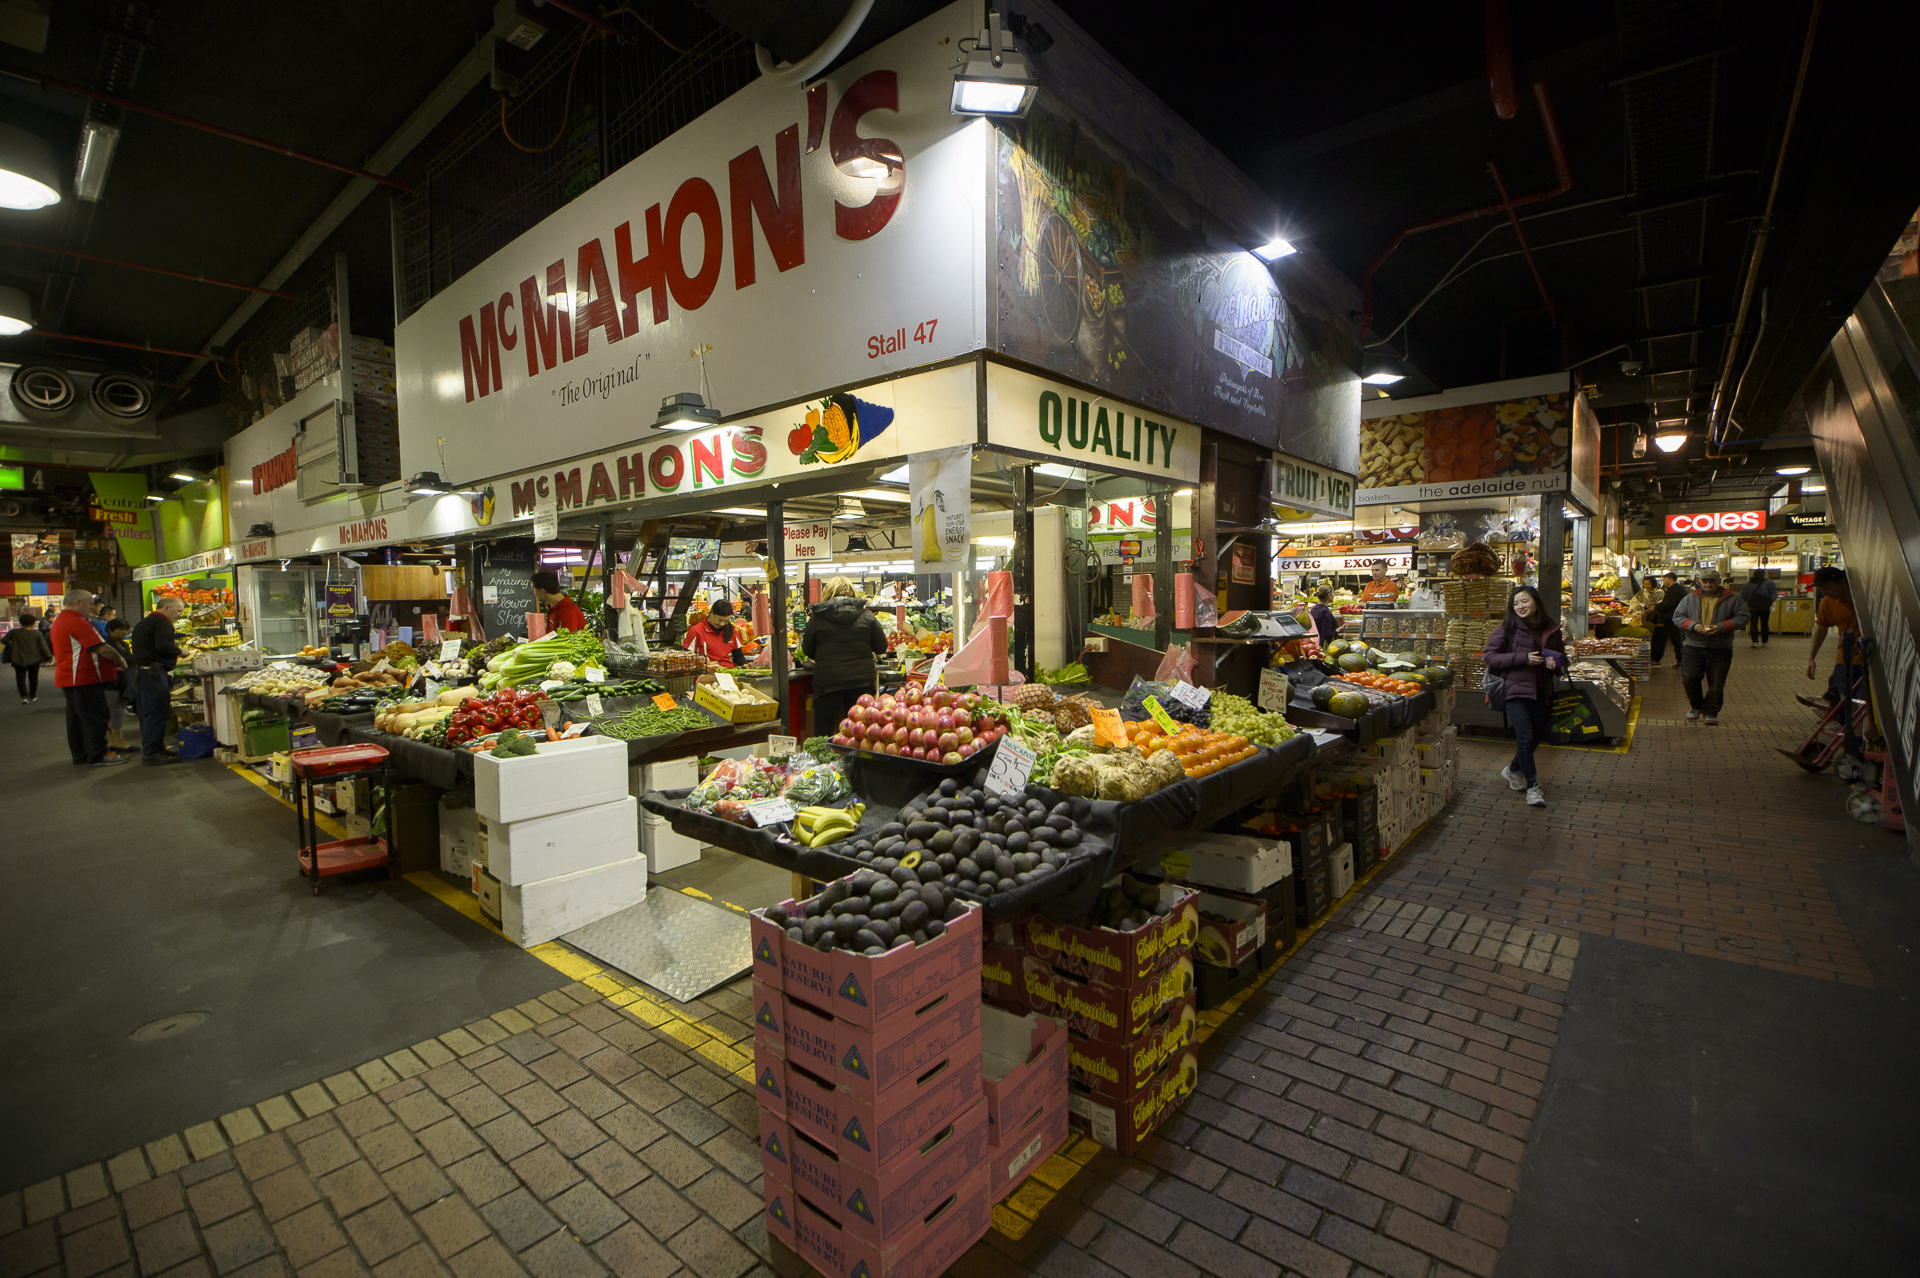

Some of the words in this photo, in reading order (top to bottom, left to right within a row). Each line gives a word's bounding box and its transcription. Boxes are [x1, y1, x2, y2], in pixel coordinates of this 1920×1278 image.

[458, 70, 906, 403] McMAHON'S
[866, 322, 908, 360] Stall
[913, 319, 939, 347] 47
[1038, 389, 1178, 469] QUALITY
[32, 469, 44, 490] 4
[510, 425, 768, 519] McMAHON'S
[1276, 459, 1320, 503] FRUIT
[1326, 475, 1350, 510] VEG
[1418, 486, 1443, 498] the
[1448, 480, 1526, 496] adelaide
[1532, 475, 1561, 490] nut
[95, 508, 133, 523] Fresh
[946, 513, 965, 521] NATURE'S
[1671, 512, 1760, 533] coles
[339, 518, 388, 545] McMAHONS
[784, 526, 811, 540] Please
[812, 524, 829, 540] Pay
[945, 527, 965, 535] ENERGY
[945, 534, 965, 545] SNACK
[795, 543, 816, 557] Here
[1780, 557, 1793, 566] shop
[500, 568, 512, 576] My
[1281, 561, 1291, 569] &
[1293, 560, 1321, 569] VEG
[1344, 557, 1396, 568] EXOC
[488, 577, 530, 590] Amazing
[496, 610, 526, 629] Shop
[1002, 738, 1036, 761] AVOCADOS
[1028, 920, 1062, 951] Fresh
[1063, 934, 1123, 973] Avocados
[1136, 929, 1158, 965] Fresh
[1024, 971, 1056, 1003] Fresh
[1056, 987, 1118, 1029] Avocados
[1131, 985, 1155, 1022] Fresh
[784, 1019, 837, 1053] NATURES
[1133, 1037, 1158, 1077] Fresh
[786, 1085, 838, 1122] NATURES
[1133, 1088, 1158, 1130] Fresh
